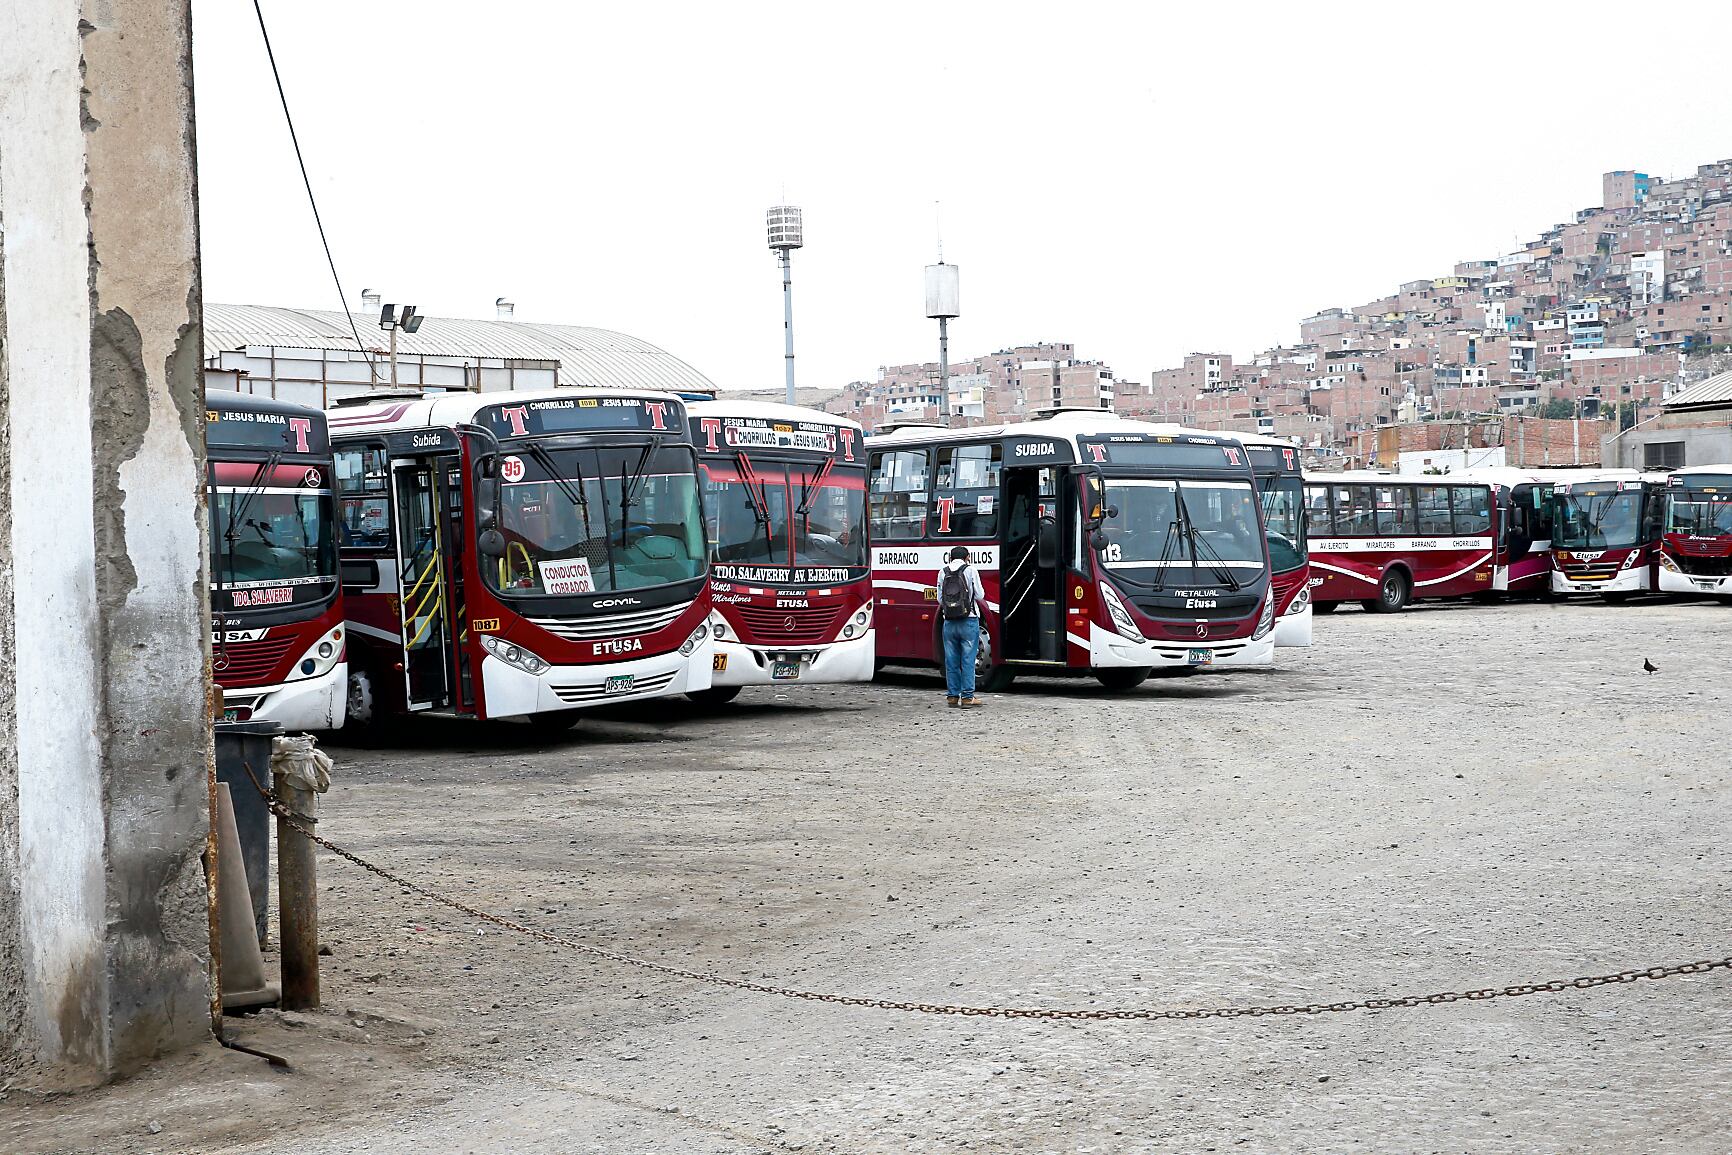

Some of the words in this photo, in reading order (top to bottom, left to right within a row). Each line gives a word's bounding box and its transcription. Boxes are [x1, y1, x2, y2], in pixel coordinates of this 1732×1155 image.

[530, 401, 574, 410] CHORRILLOS
[602, 400, 622, 408] JESUS
[223, 412, 254, 421] JESUS
[256, 414, 286, 424] MARIA
[502, 405, 530, 437] T
[645, 401, 668, 431] T
[723, 418, 744, 427] JESUS
[746, 419, 767, 428] MARIA
[289, 417, 311, 453] T
[412, 434, 442, 448] Subida
[701, 418, 721, 453] T
[738, 430, 777, 446] CHORRILLOS
[793, 435, 810, 447] JESUS
[811, 436, 828, 449] MARIA
[840, 428, 855, 461] T
[1015, 443, 1056, 456] SUBIDA
[1087, 444, 1107, 462] T
[1222, 447, 1242, 466] T
[1282, 448, 1294, 471] T
[504, 460, 522, 477] 95
[936, 495, 955, 533] T
[879, 552, 919, 565] BARRANCO
[943, 551, 993, 564] CILLOS
[544, 565, 589, 580] CONDUCTOR
[715, 566, 737, 578] TDO.
[737, 568, 790, 582] SALAVERRY
[793, 570, 806, 582] AV.
[807, 568, 849, 581] EJERCITO
[550, 580, 590, 594] COBRADOR
[232, 591, 251, 607] TDO.
[251, 587, 293, 605] SALAVERRY
[712, 594, 751, 604] Miraflores
[776, 600, 809, 608] ETUSA
[1185, 599, 1217, 609] Etusa
[473, 620, 499, 630] 1087
[592, 638, 642, 655] ETUSA
[606, 677, 633, 694] APS-928
